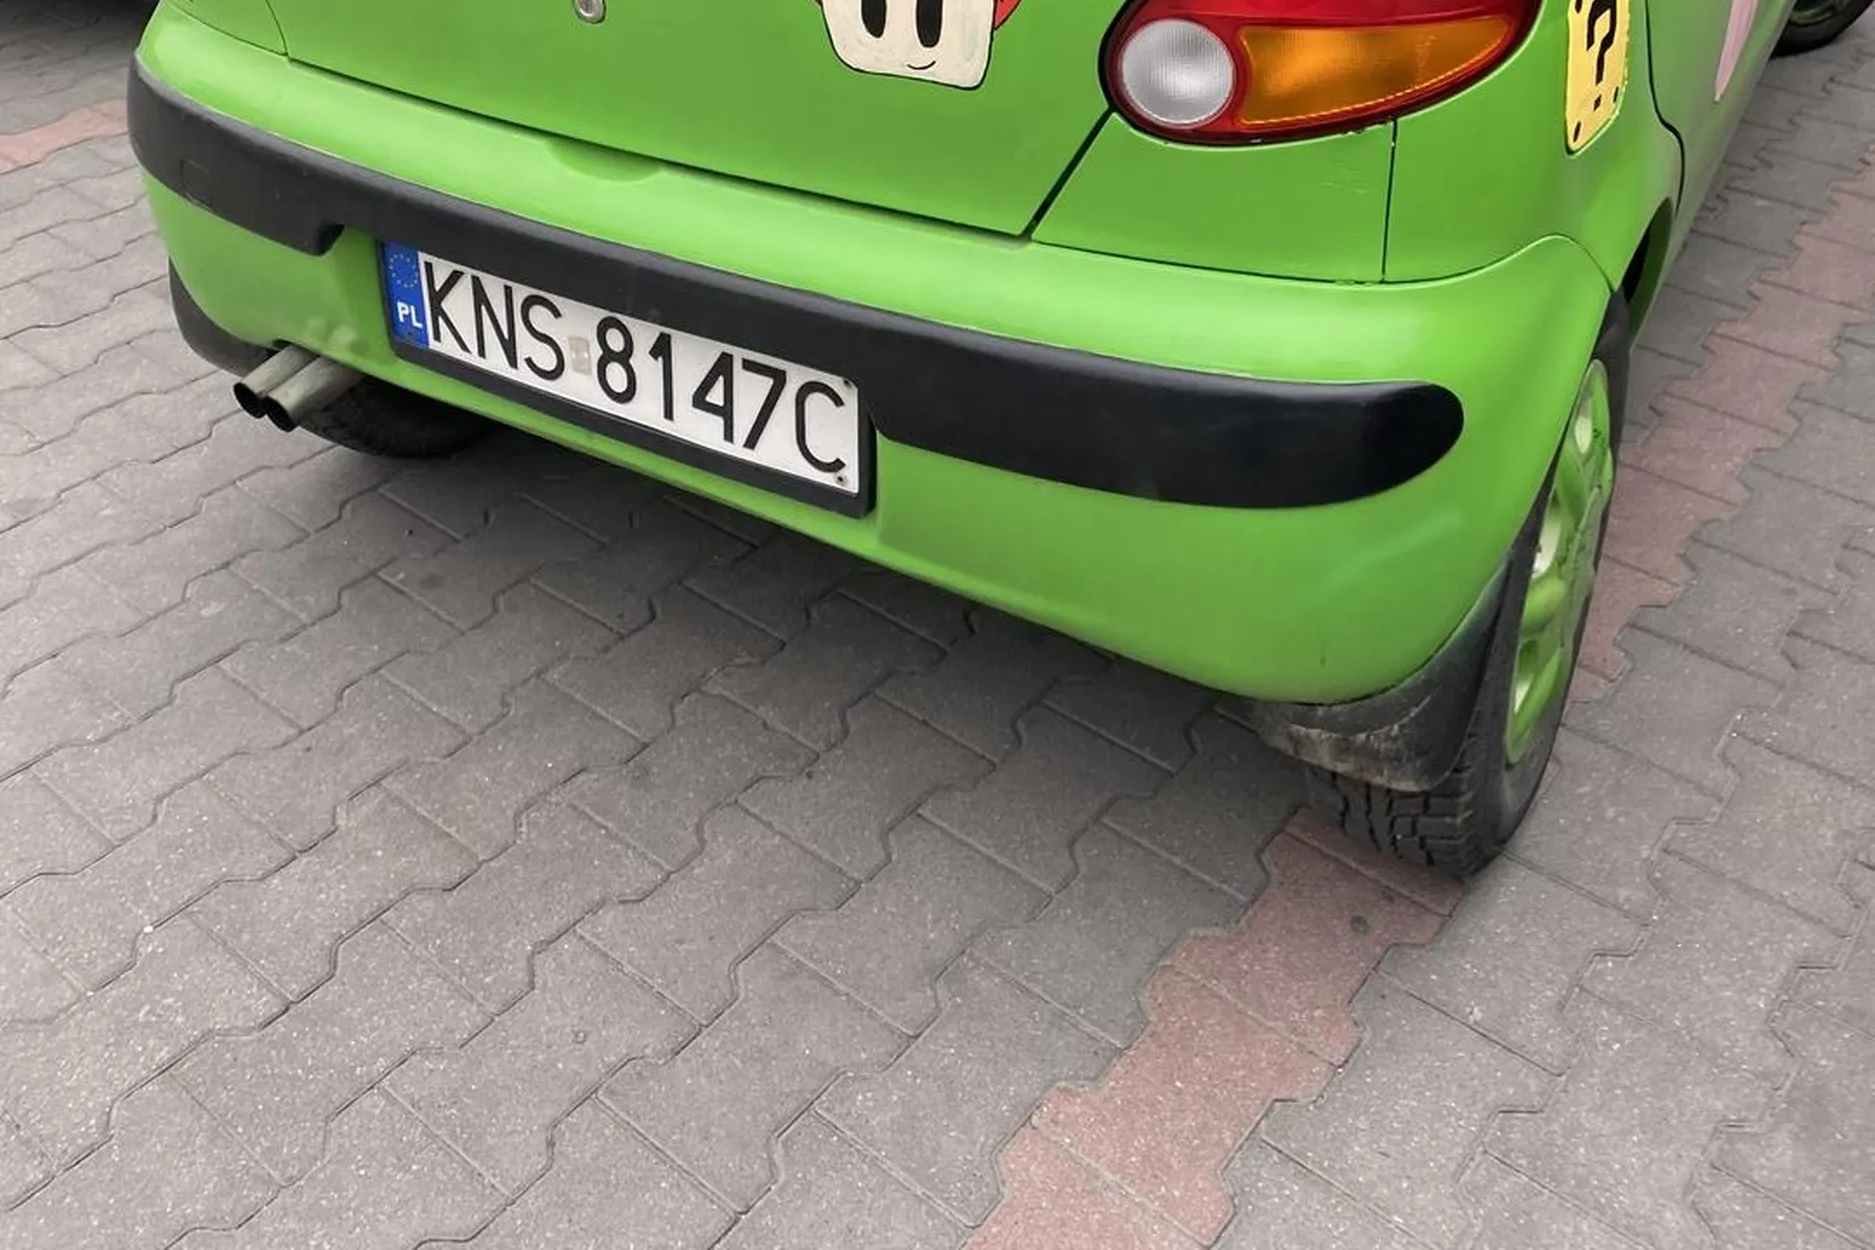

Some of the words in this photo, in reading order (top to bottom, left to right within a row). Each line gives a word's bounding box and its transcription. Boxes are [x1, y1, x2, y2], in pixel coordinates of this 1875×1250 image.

[397, 301, 423, 328] PL
[424, 261, 566, 381] KNS
[596, 316, 847, 474] 8147C
